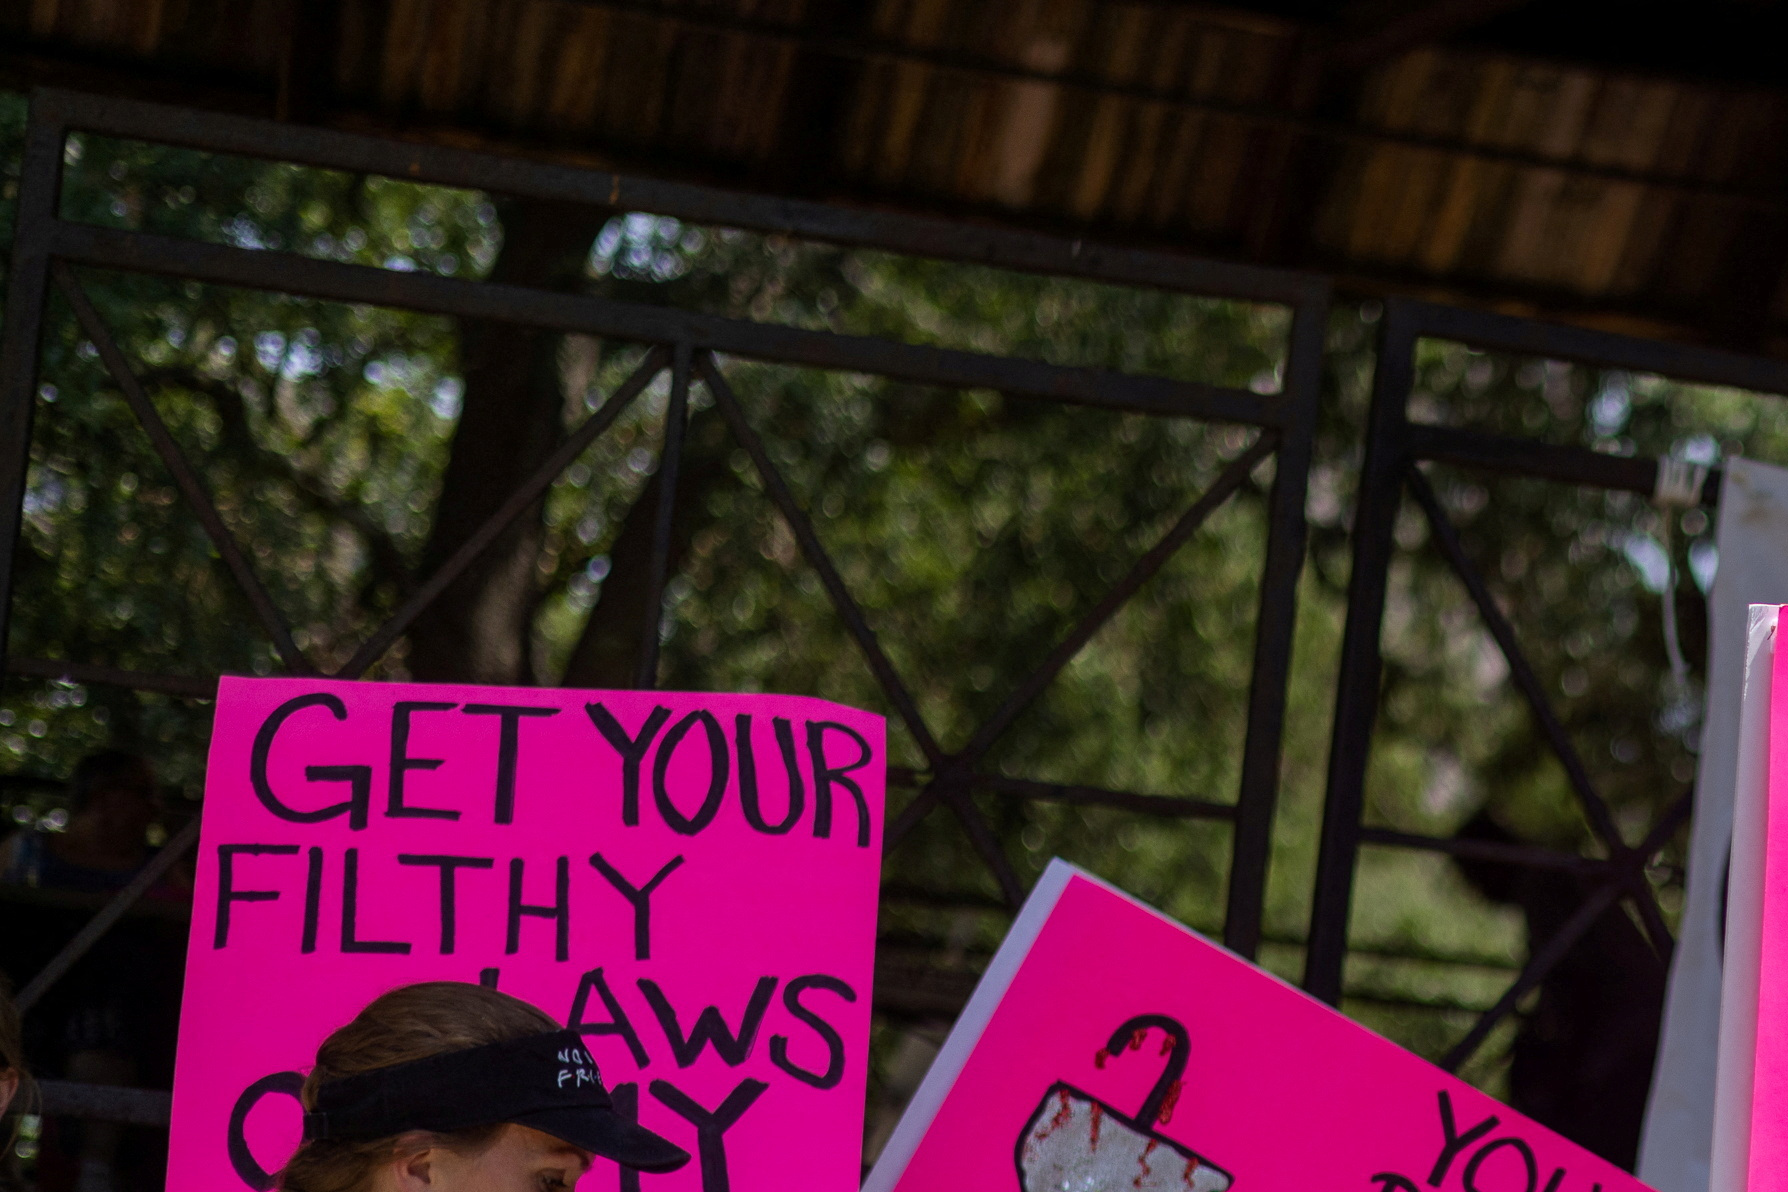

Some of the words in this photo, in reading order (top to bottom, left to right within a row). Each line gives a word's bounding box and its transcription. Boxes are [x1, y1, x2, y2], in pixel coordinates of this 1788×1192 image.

[250, 692, 562, 832] GET
[584, 702, 874, 849] YOUR
[213, 844, 685, 962] FILTHY
[480, 967, 858, 1090] AWS
